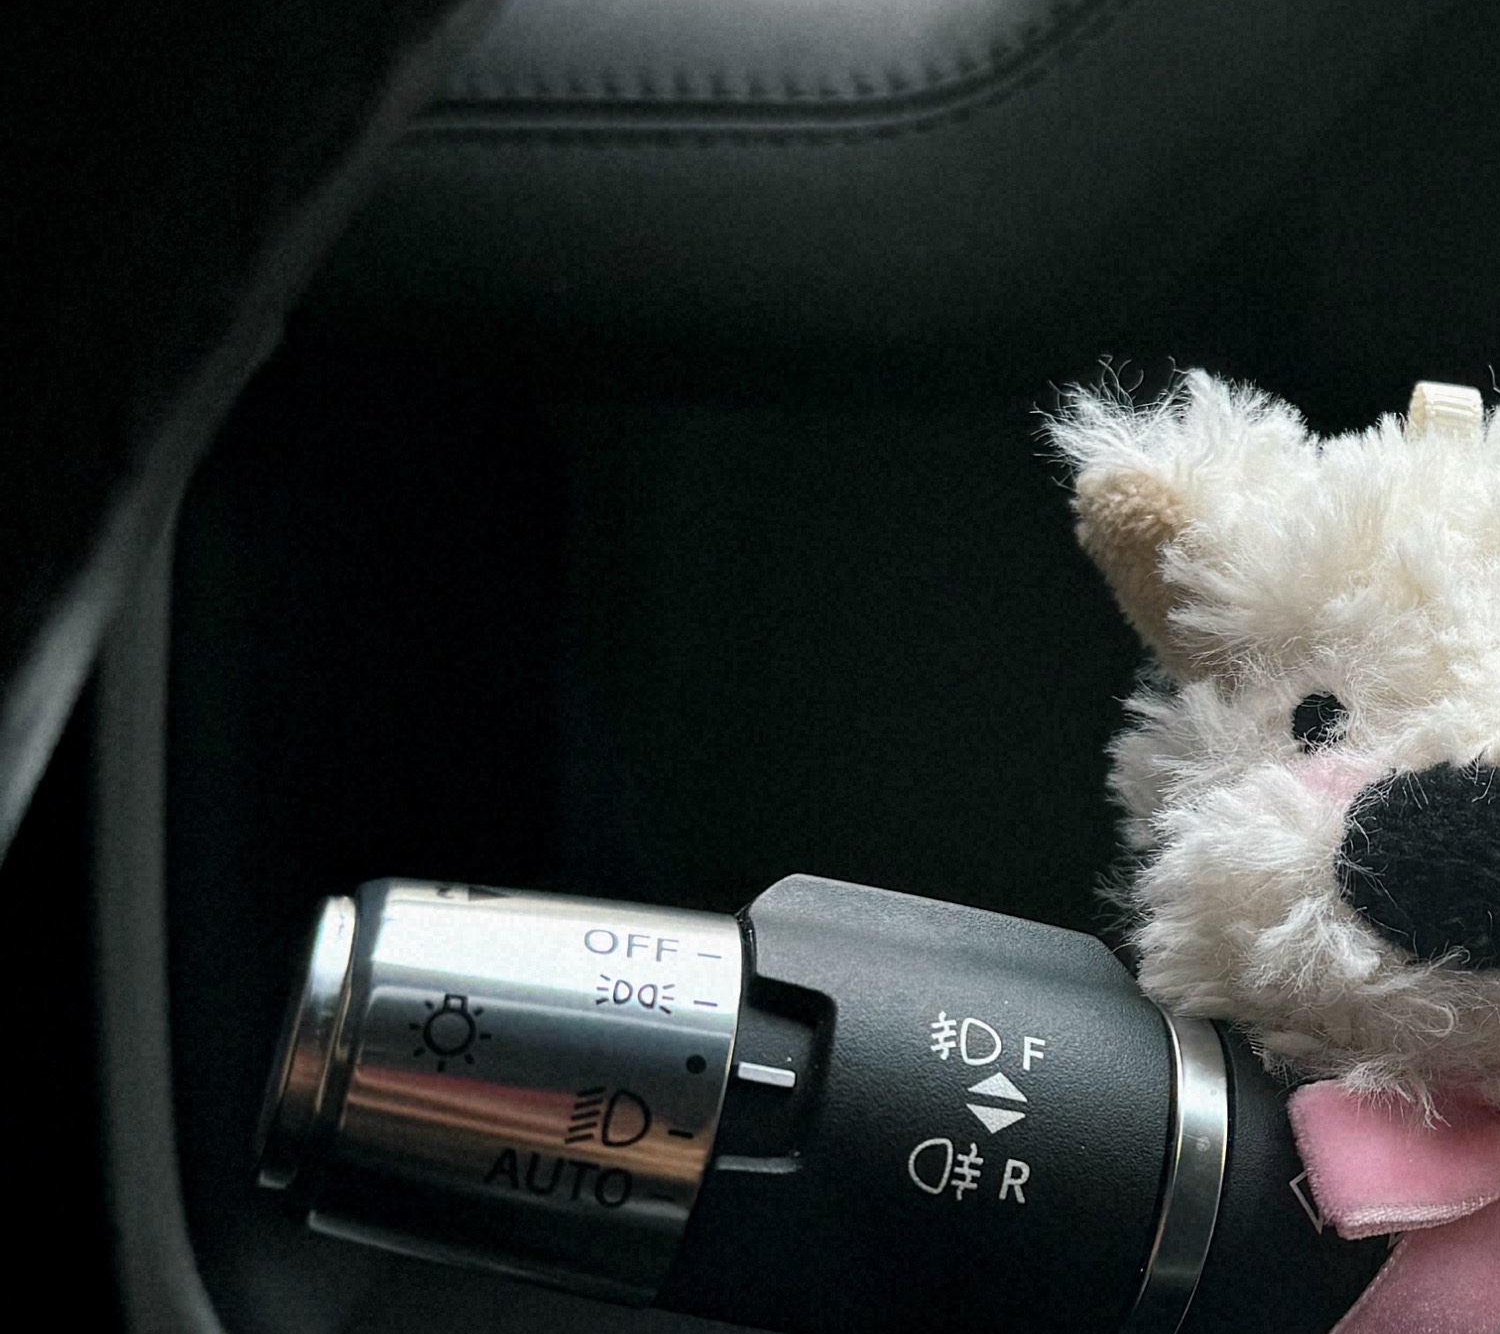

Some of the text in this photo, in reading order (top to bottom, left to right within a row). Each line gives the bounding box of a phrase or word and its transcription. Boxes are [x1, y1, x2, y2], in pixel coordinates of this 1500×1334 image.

[583, 928, 680, 963] OFF
[1022, 1035, 1047, 1072] F
[482, 1147, 634, 1209] AUTO
[998, 1158, 1031, 1204] R
